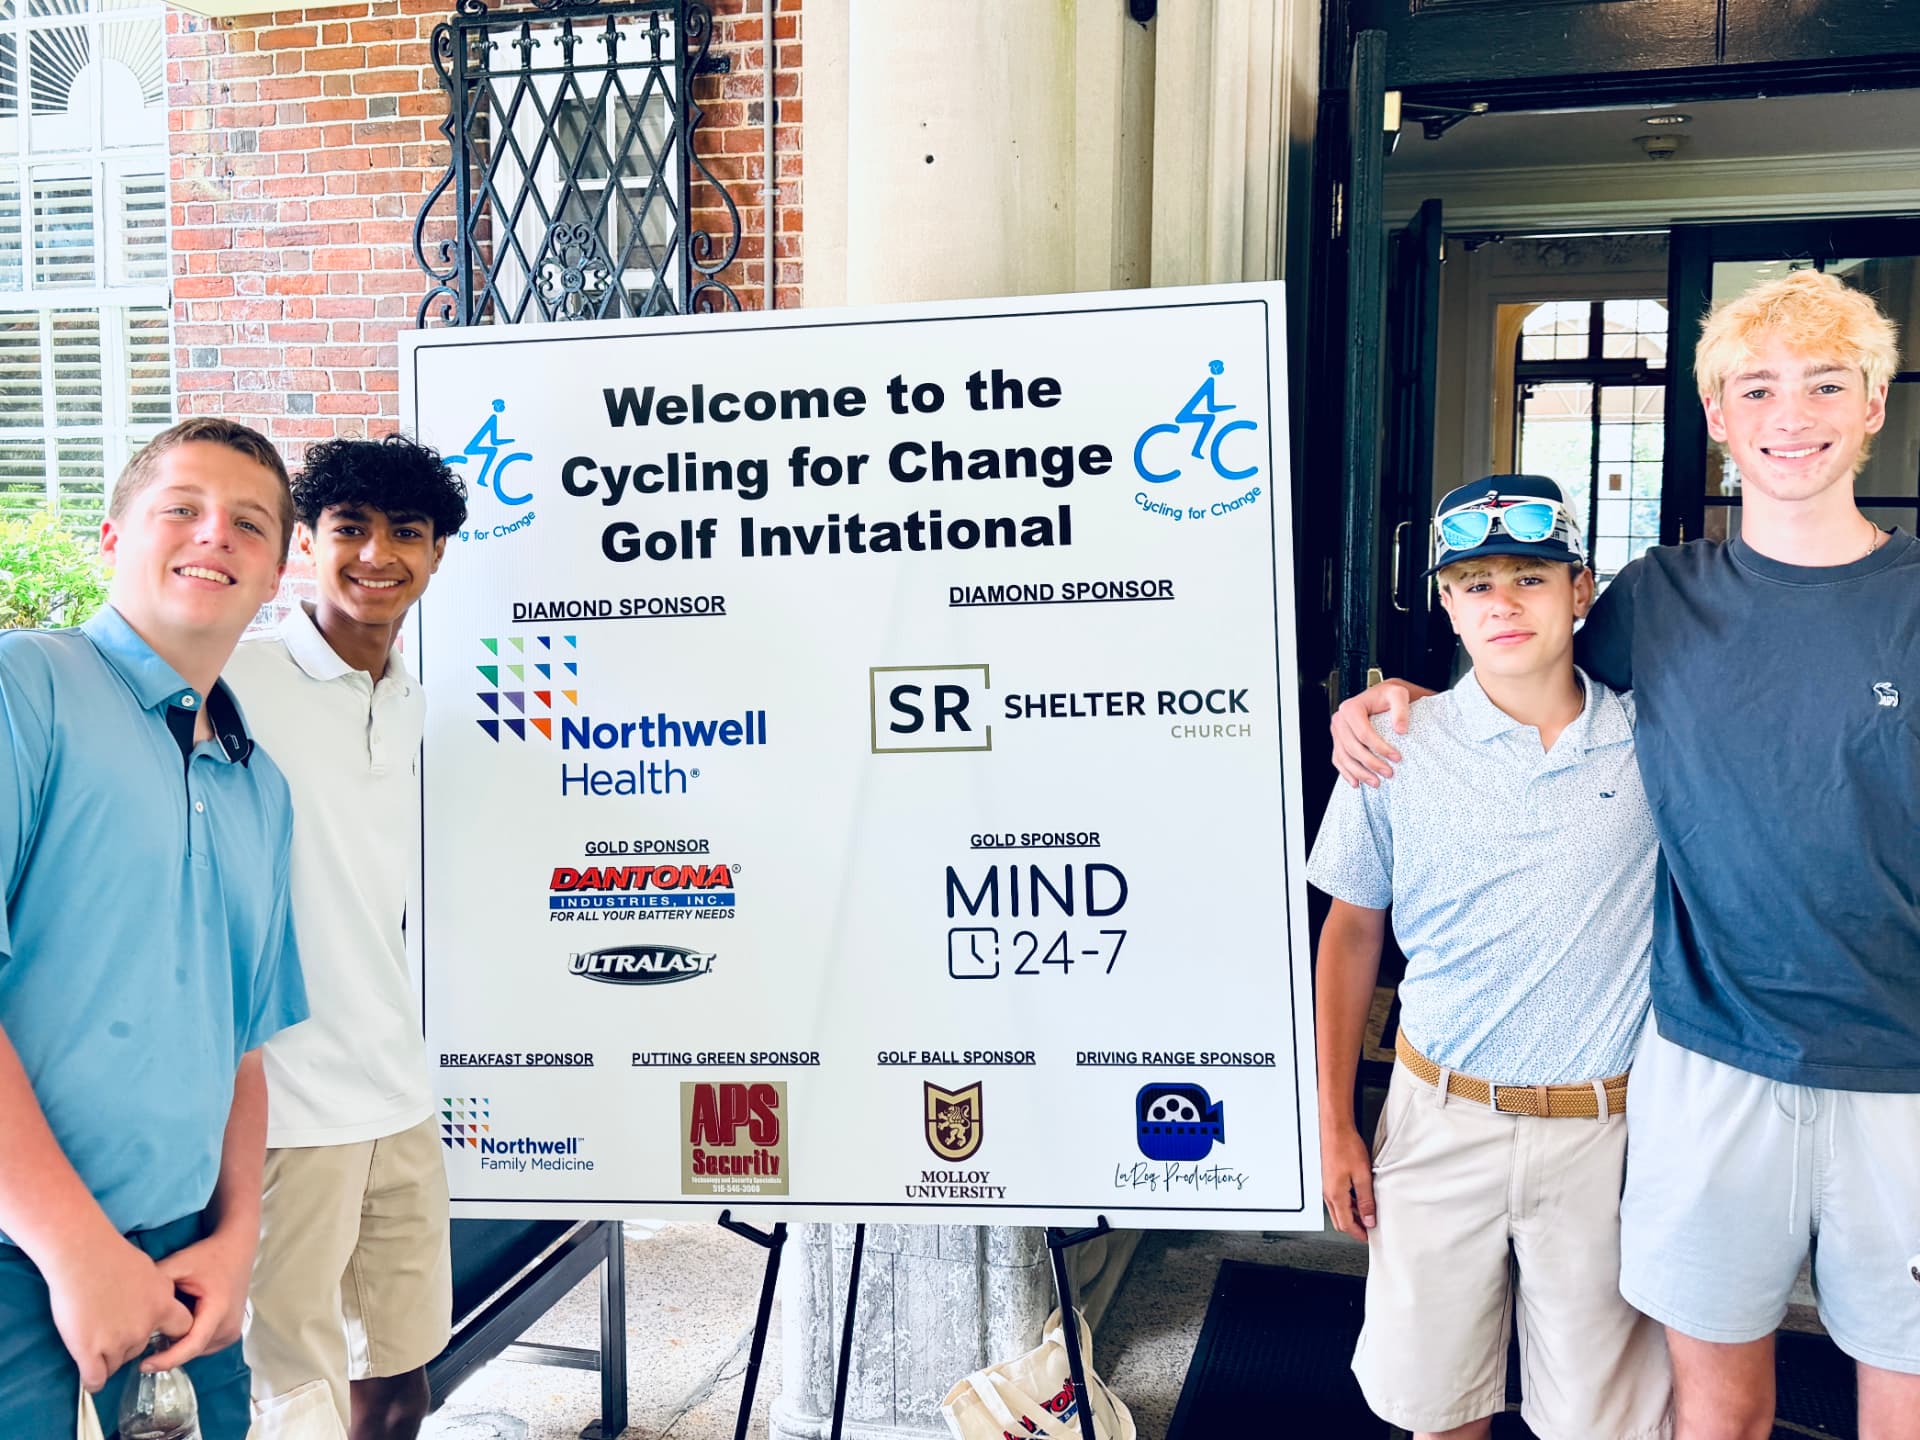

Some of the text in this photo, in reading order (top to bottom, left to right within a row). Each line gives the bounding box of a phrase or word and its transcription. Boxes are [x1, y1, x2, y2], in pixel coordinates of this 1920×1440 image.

[603, 369, 1062, 427] Welcome to the
[562, 441, 1113, 506] Cycling for Change
[1134, 486, 1262, 521] Cycling for Change
[474, 529, 490, 540] for
[493, 511, 536, 537] Change
[602, 505, 1072, 562] Golf Invitational
[949, 579, 1174, 604] DIAMOND SPONSOR
[513, 595, 726, 620] DIAMOND SPONSOR
[889, 684, 972, 734] SR
[1004, 688, 1250, 719] SHELTER ROCK
[561, 710, 767, 750] Northwell
[1170, 723, 1252, 738] CHURCH
[585, 839, 709, 854] GOLD SPONSOR
[970, 832, 1100, 847] GOLD SPONSOR
[550, 864, 734, 891] DANTONA
[560, 895, 725, 908] INDUSTRIES, INC.
[946, 863, 1128, 918] MIND
[550, 908, 735, 922] FOR ALL YOUR BATTERY NEEDS
[568, 952, 717, 975] ULTRALAST
[1013, 930, 1127, 975] 24-7
[440, 1053, 594, 1066] BREAKFAST SPONSOR
[632, 1051, 820, 1065] PUTTING GREEN SPONSOR
[877, 1050, 1036, 1064] GOLF BALL SPONSOR
[1076, 1051, 1276, 1066] DRIVING RANGE SPONSOR
[690, 1083, 780, 1147] APS
[481, 1137, 577, 1154] Northwell
[481, 1157, 594, 1172] Family Medicine
[692, 1148, 780, 1176] Security
[921, 1171, 990, 1184] MOLLOY
[1163, 1160, 1250, 1192] Productions
[905, 1185, 1007, 1199] UNIVERSITY
